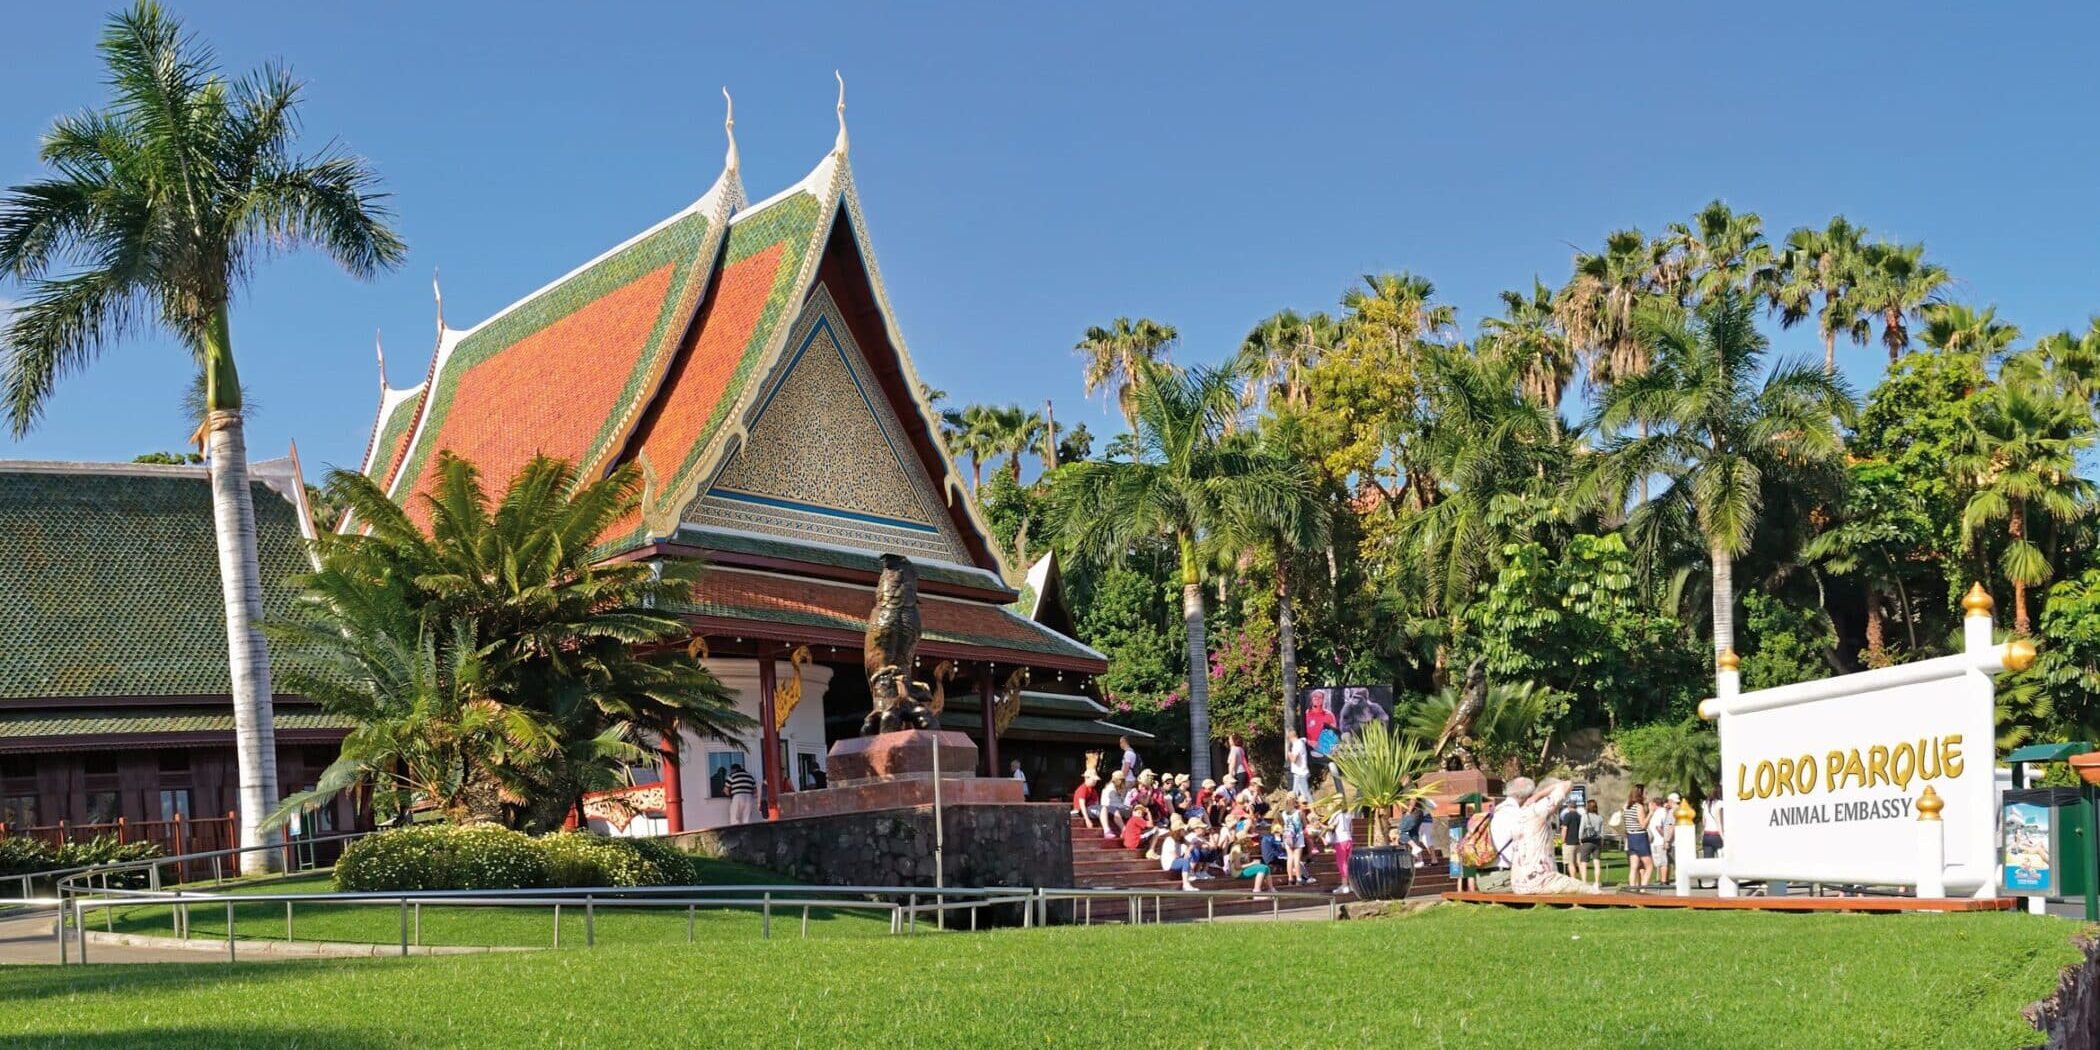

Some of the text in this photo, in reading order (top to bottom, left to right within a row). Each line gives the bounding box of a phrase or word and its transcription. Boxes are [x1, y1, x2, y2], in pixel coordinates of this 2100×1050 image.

[1737, 734, 1964, 801] LORO PARQUE
[1769, 797, 1912, 827] ANIMAL EMBASSY
